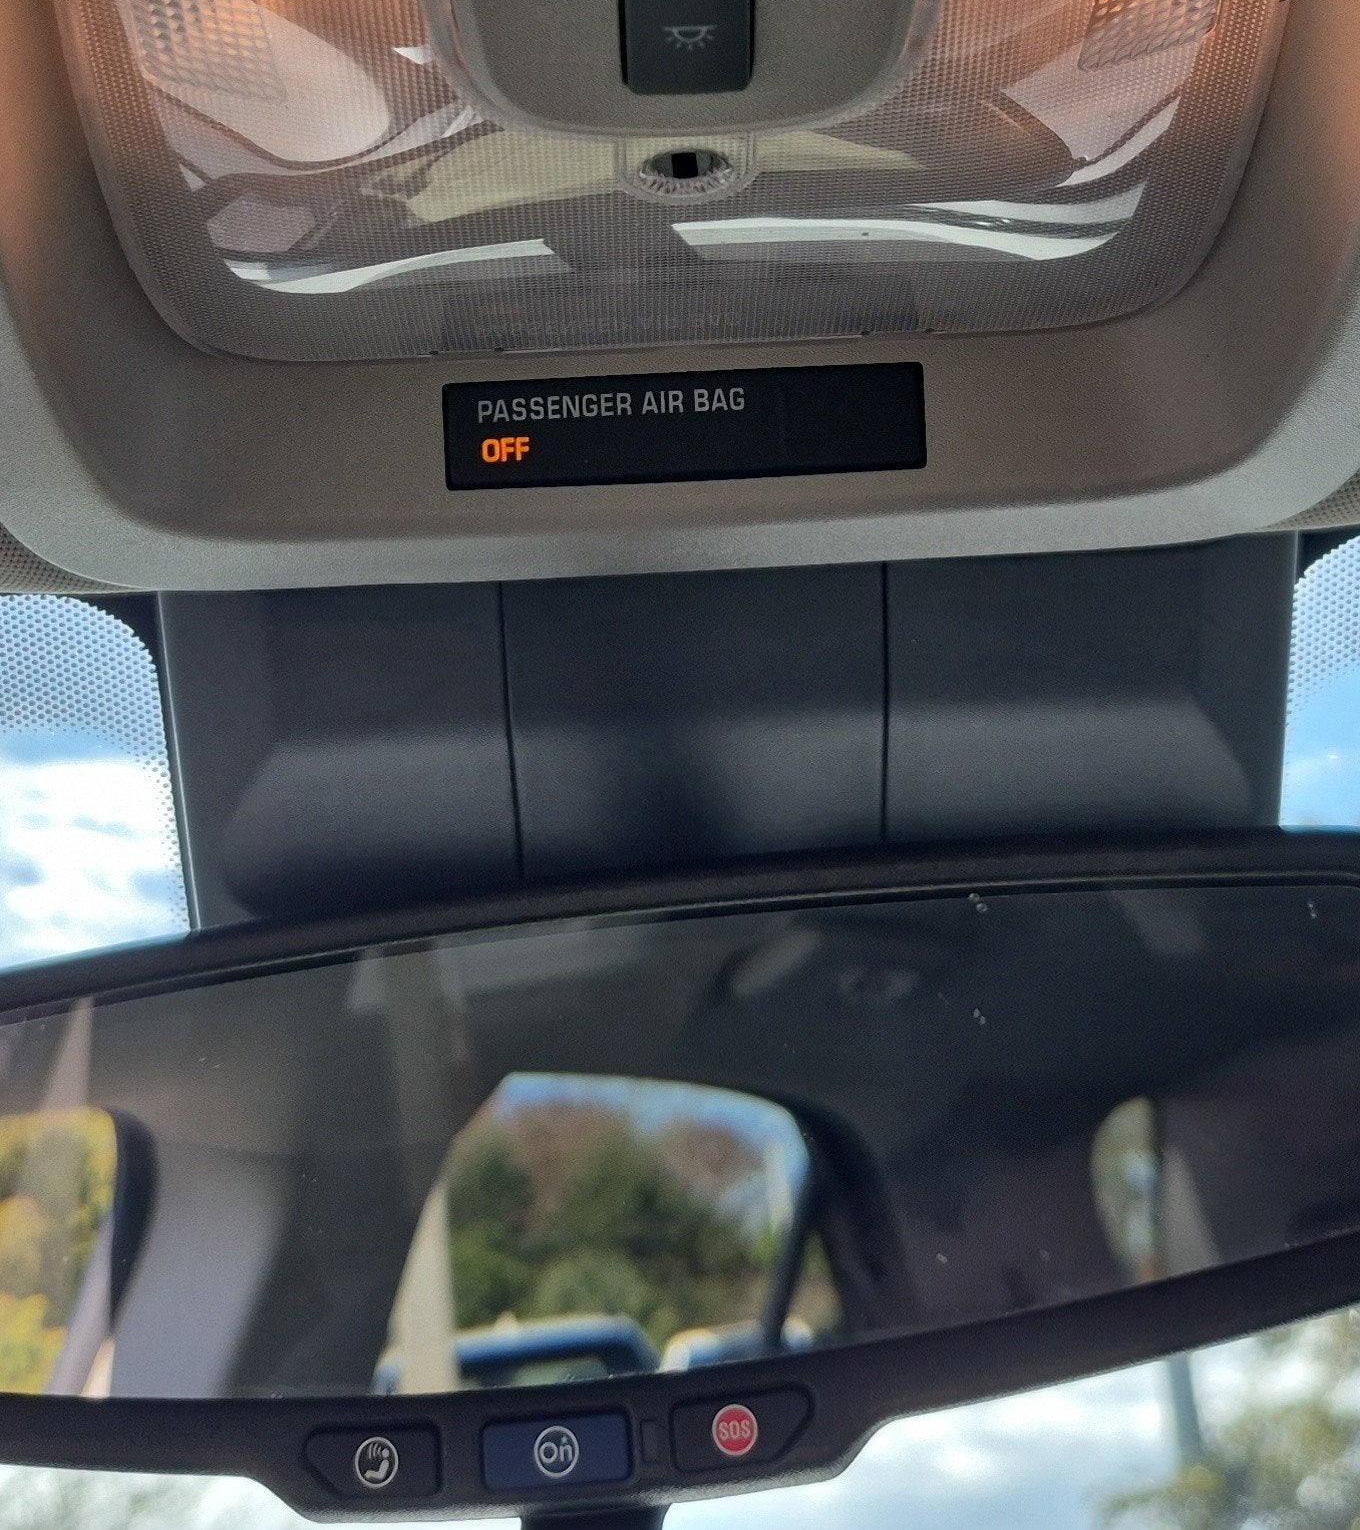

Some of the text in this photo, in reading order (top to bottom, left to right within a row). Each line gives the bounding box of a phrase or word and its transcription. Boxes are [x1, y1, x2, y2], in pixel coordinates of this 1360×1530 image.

[478, 387, 745, 423] PASSENGER AIR BAG
[481, 436, 530, 463] OFF
[718, 1419, 751, 1441] SOS
